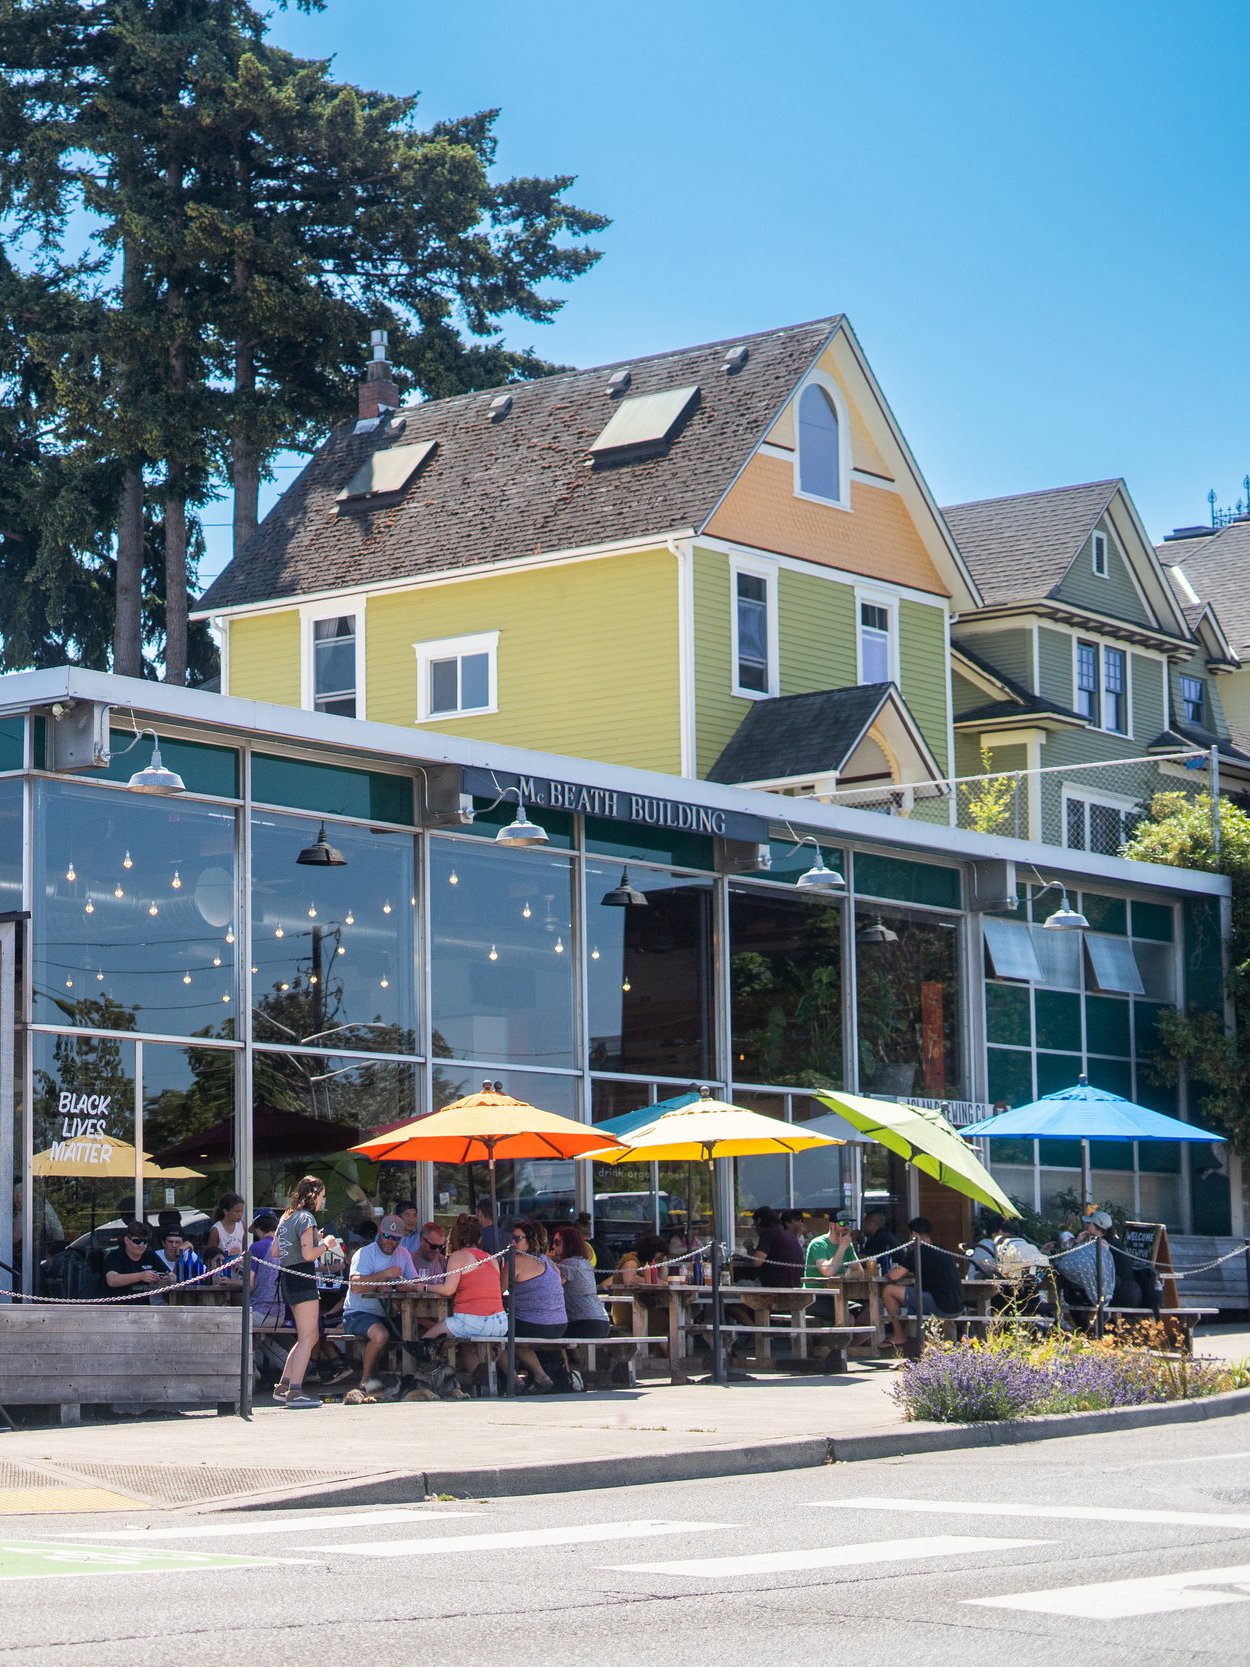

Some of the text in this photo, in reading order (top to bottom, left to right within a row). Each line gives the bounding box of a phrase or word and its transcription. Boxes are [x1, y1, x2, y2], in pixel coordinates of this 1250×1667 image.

[631, 795, 726, 834] BUILDING
[58, 1091, 111, 1115] BLACK
[62, 1117, 106, 1140] LIVES
[50, 1140, 113, 1164] MATTER
[598, 1167, 624, 1178] drink
[1126, 1231, 1155, 1242] WELCOME
